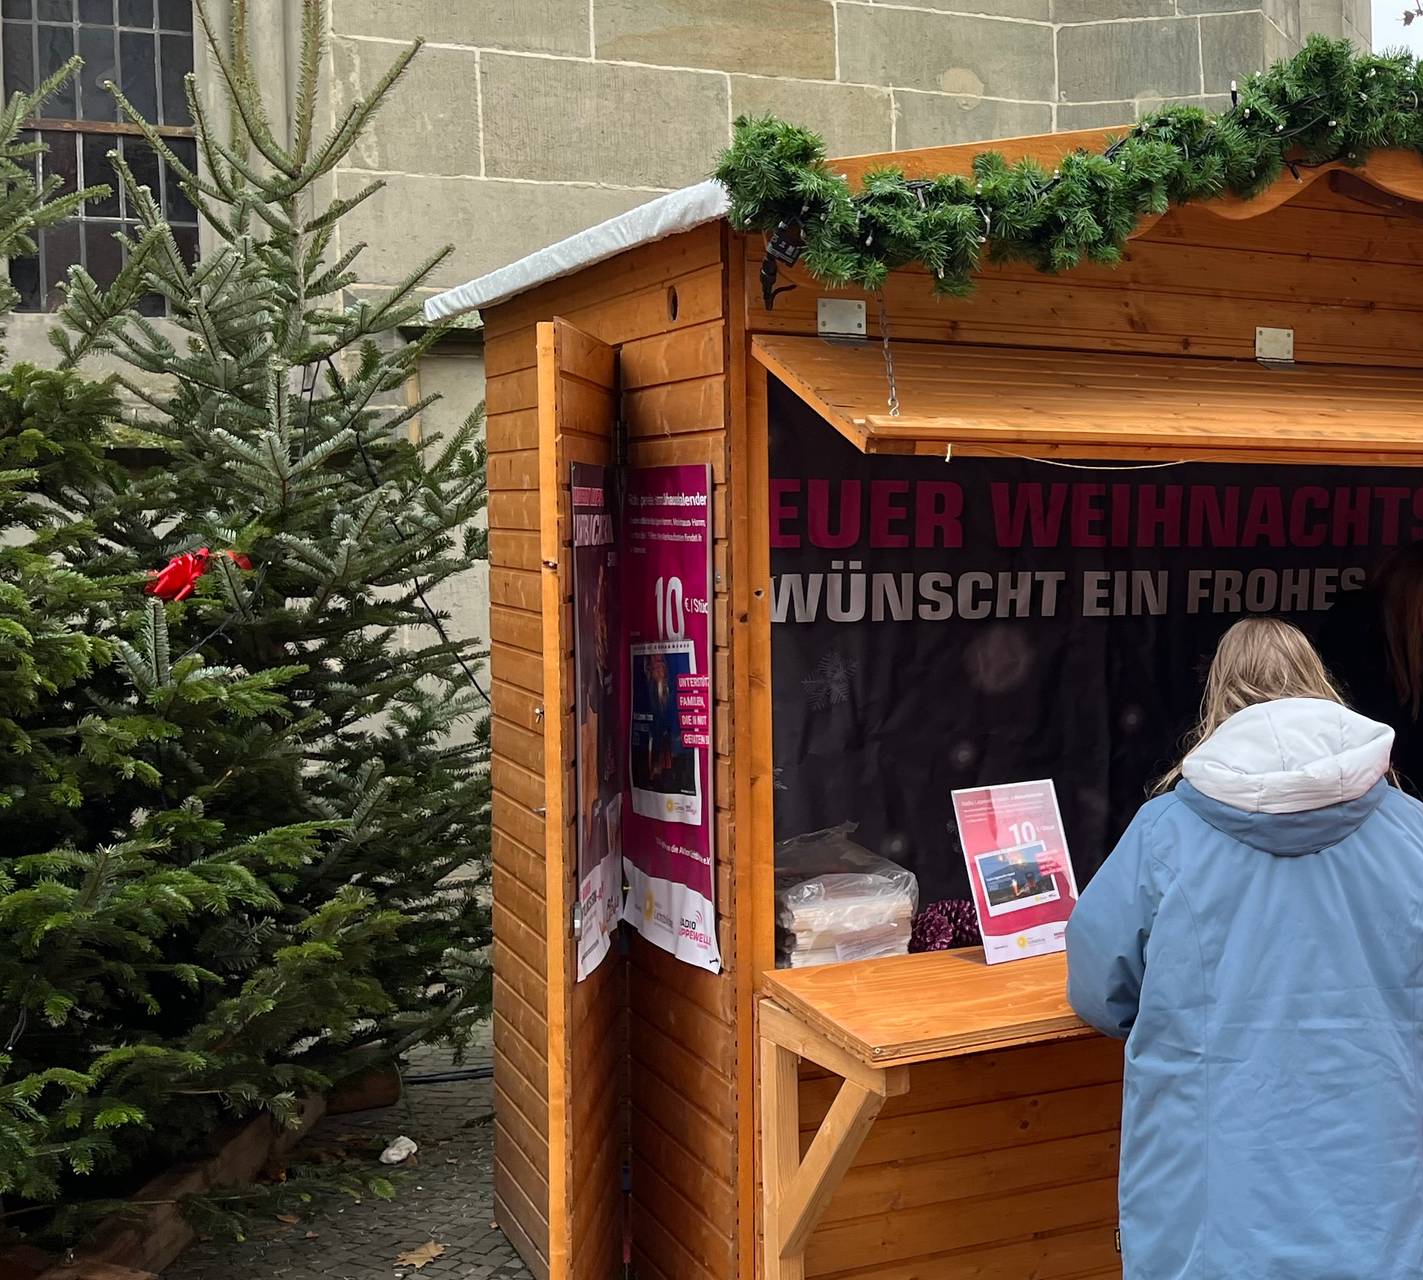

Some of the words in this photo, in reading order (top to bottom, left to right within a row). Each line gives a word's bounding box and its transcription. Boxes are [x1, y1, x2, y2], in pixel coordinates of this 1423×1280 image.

[770, 478, 964, 549] EUER
[655, 576, 686, 640] 10
[770, 559, 1066, 623] WÜNSCHT
[1082, 569, 1169, 617] EIN
[1008, 821, 1037, 847] 10
